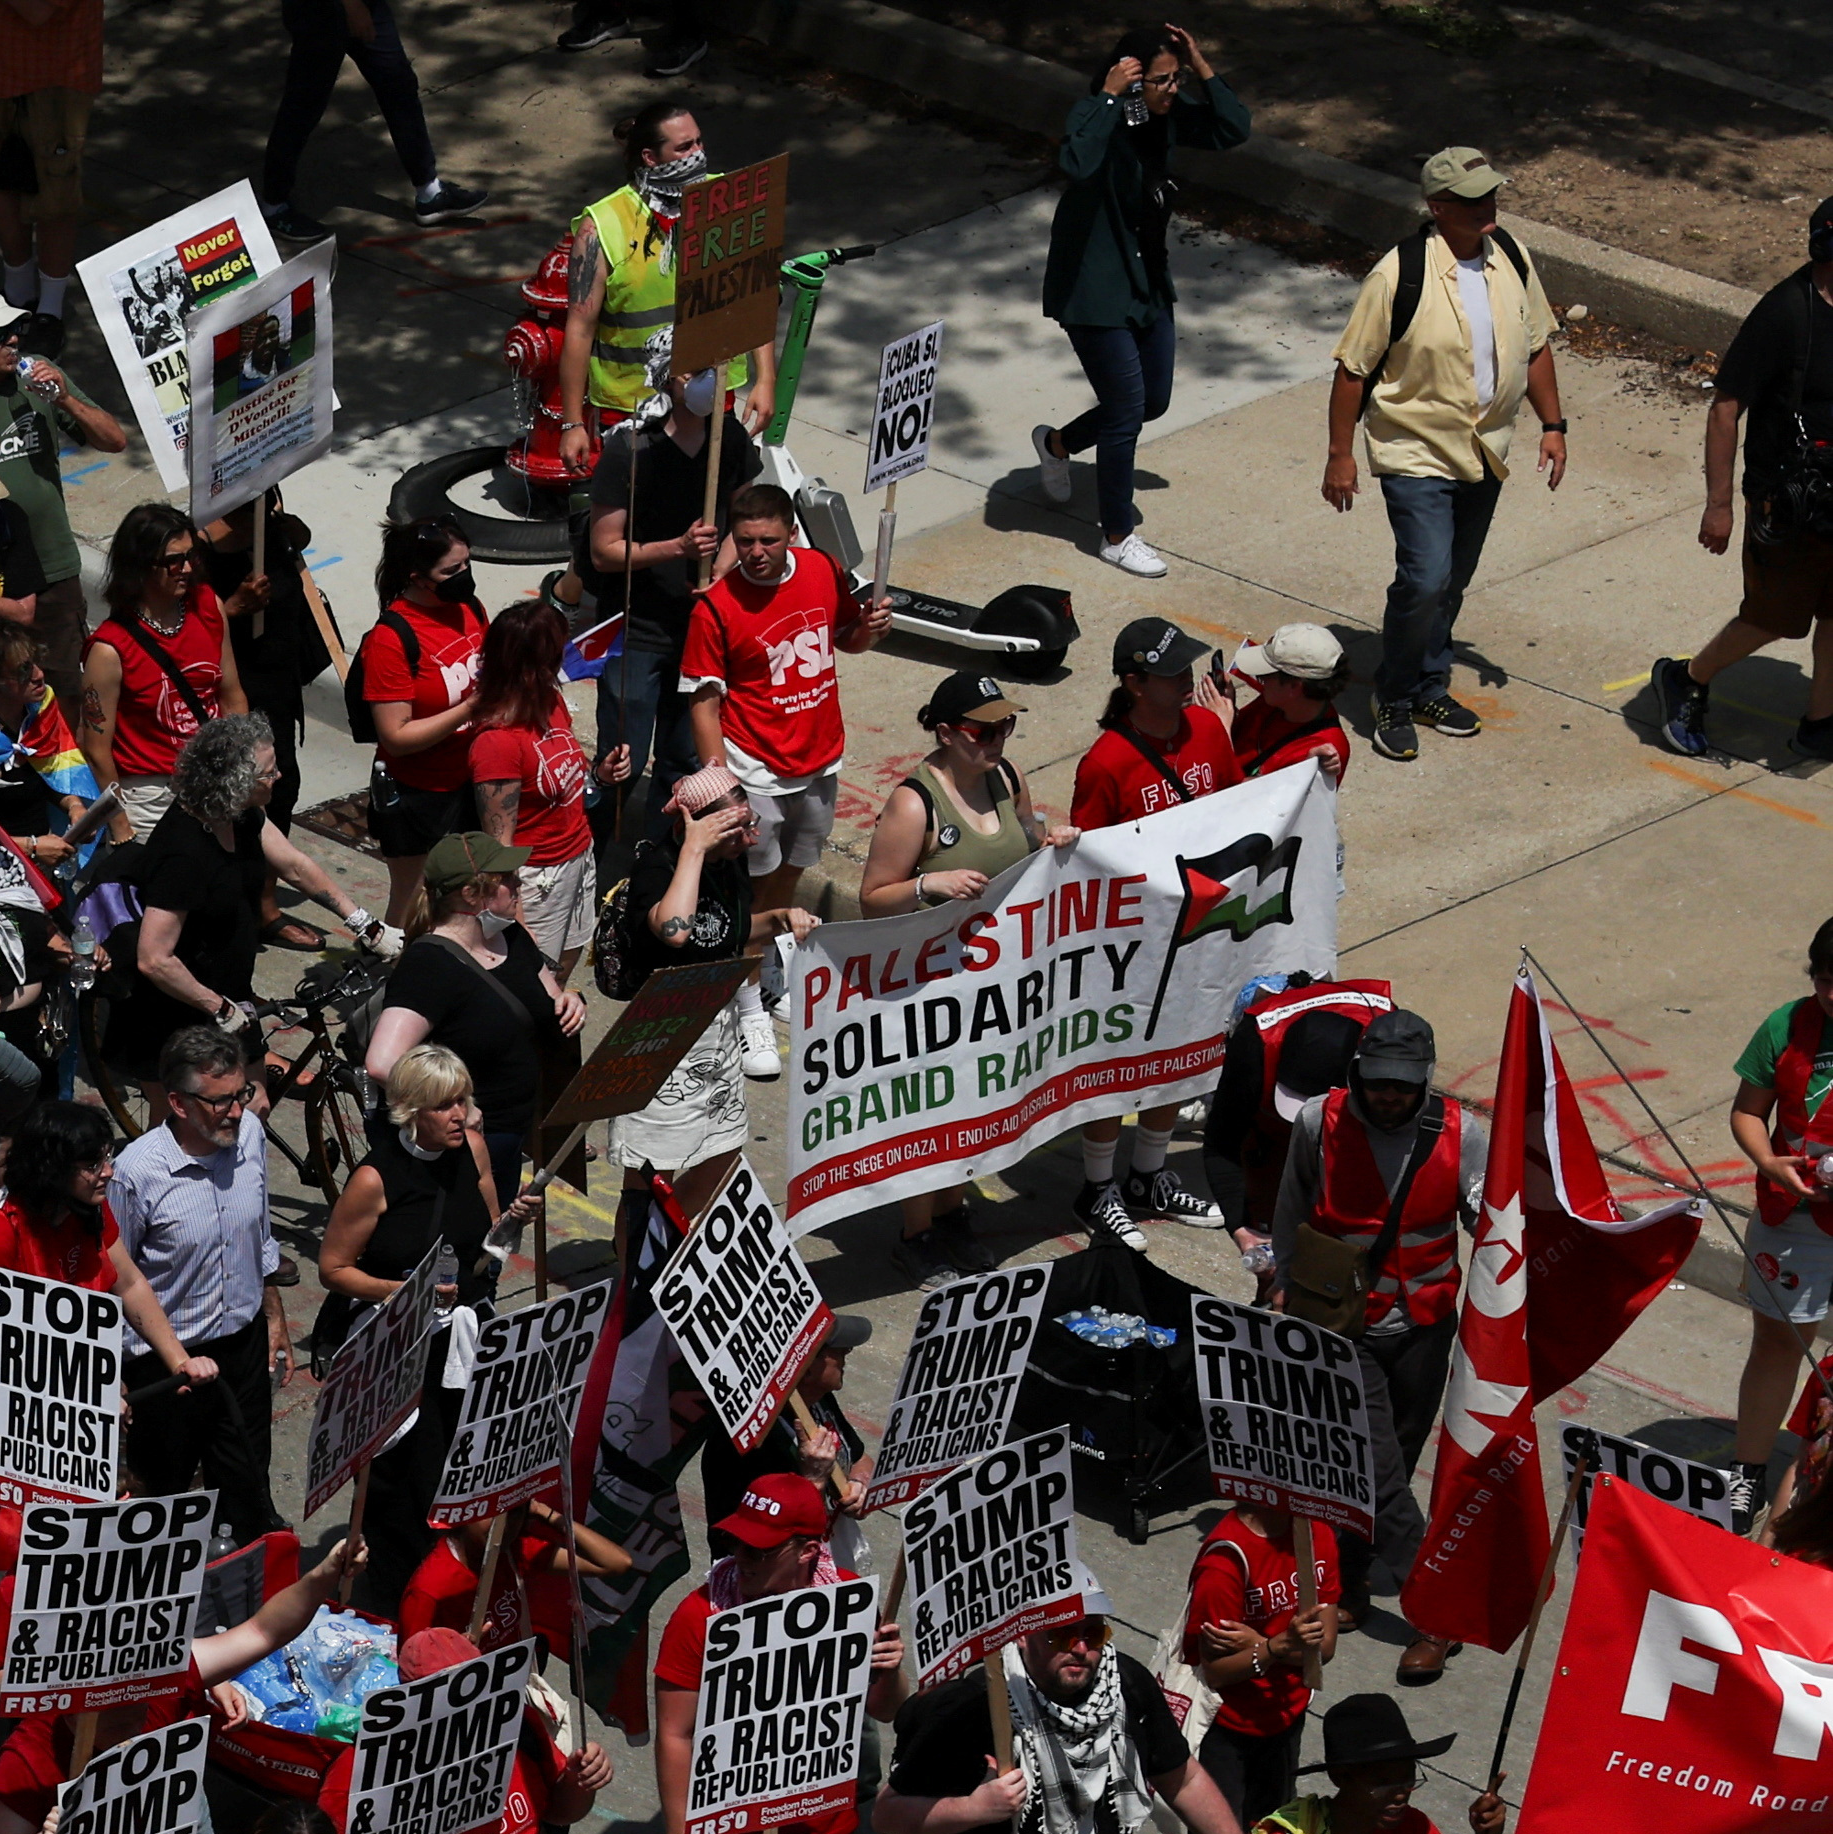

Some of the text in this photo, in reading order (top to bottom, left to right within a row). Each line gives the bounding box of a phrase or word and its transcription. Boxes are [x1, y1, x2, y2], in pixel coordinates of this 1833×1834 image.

[183, 227, 237, 263] Never
[190, 253, 252, 292] Forget
[227, 375, 299, 423] Justice for
[228, 389, 297, 437] D'Vontaye
[881, 366, 935, 413] BLOQUEO
[233, 405, 292, 447] Mitchell!
[873, 398, 931, 465] NO!
[804, 874, 1147, 1030] PALESTINE
[803, 940, 1142, 1096] SOLIDARITY
[802, 1004, 1134, 1152] GRAND RAPIDS
[1073, 1062, 1160, 1092] POWER TO THE
[957, 1117, 1019, 1148] END US AID
[802, 1139, 938, 1198] STOP THE SIEGE ON GAZA
[1605, 1750, 1827, 1815] Freedom Road
